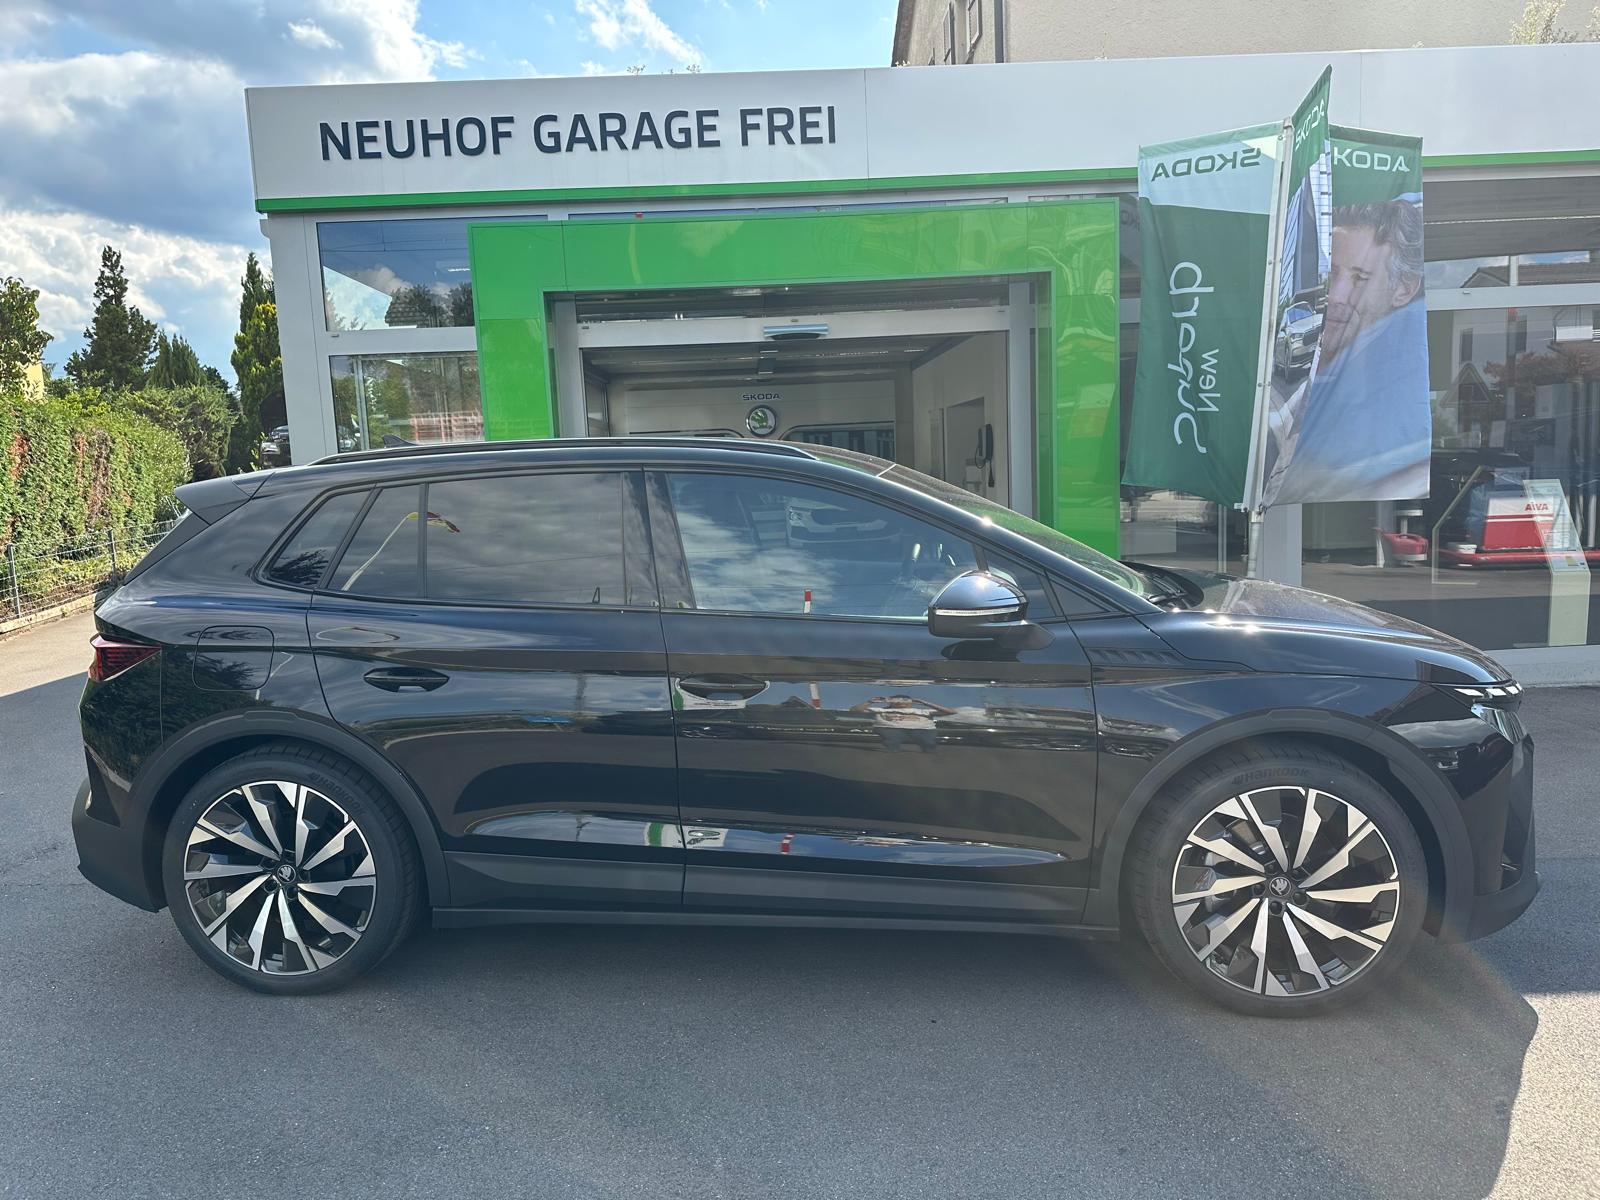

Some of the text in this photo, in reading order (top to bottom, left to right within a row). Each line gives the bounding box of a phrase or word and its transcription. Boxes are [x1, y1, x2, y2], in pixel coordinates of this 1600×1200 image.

[319, 105, 837, 161] NEUHOF GARAGE FREI
[1333, 146, 1410, 173] KODA
